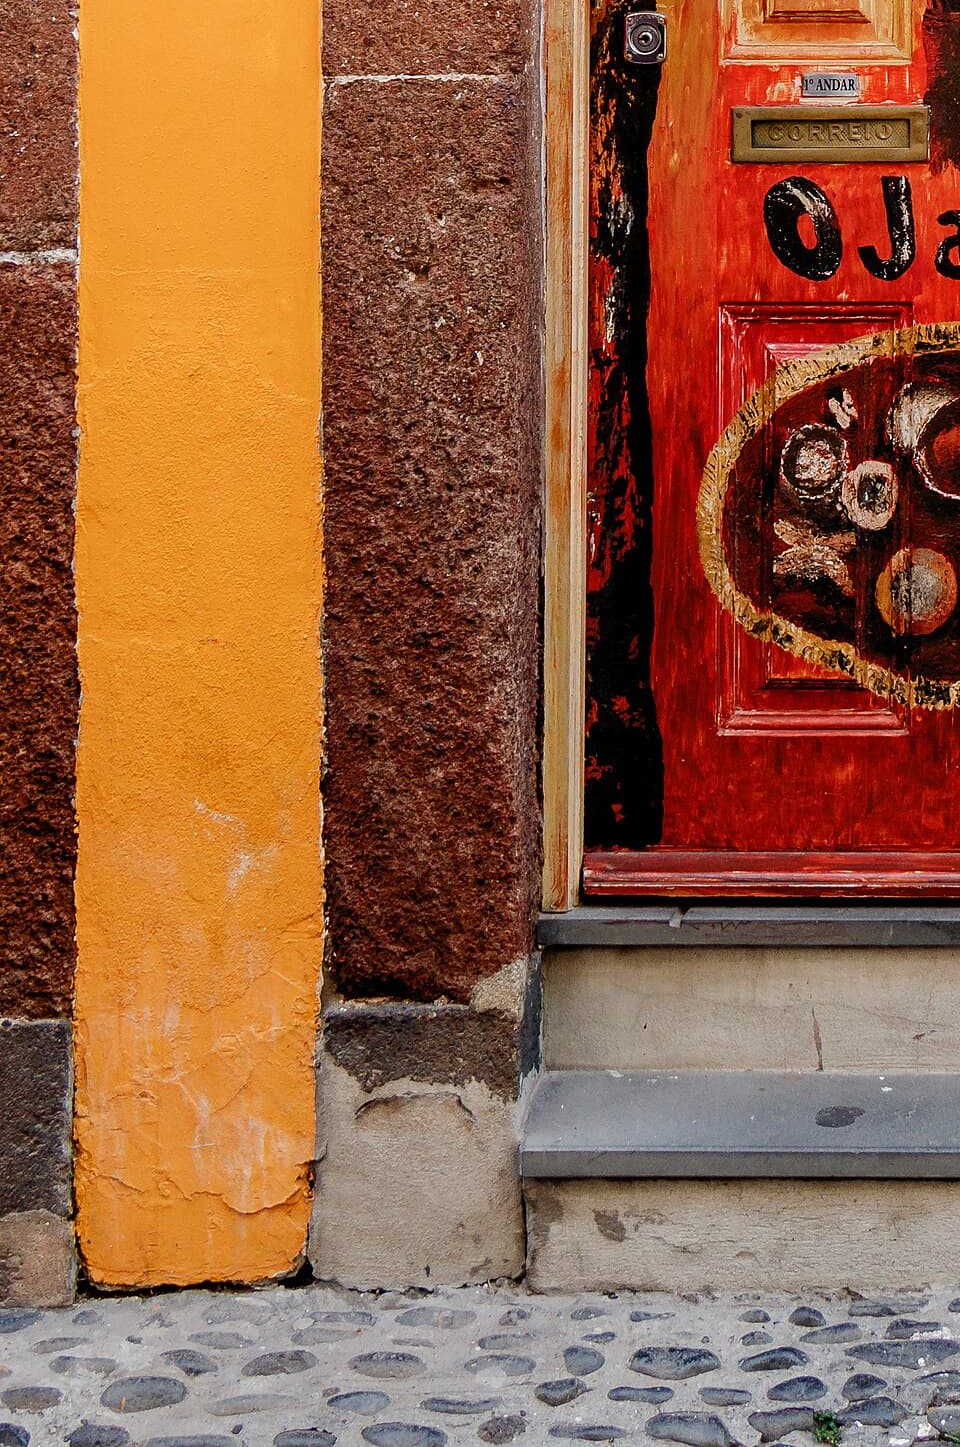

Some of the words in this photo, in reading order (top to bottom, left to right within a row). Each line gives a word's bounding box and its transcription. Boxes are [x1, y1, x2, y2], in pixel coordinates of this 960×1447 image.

[804, 78, 813, 91] 1º
[815, 78, 855, 91] ANDAR
[767, 121, 893, 141] CORREIO
